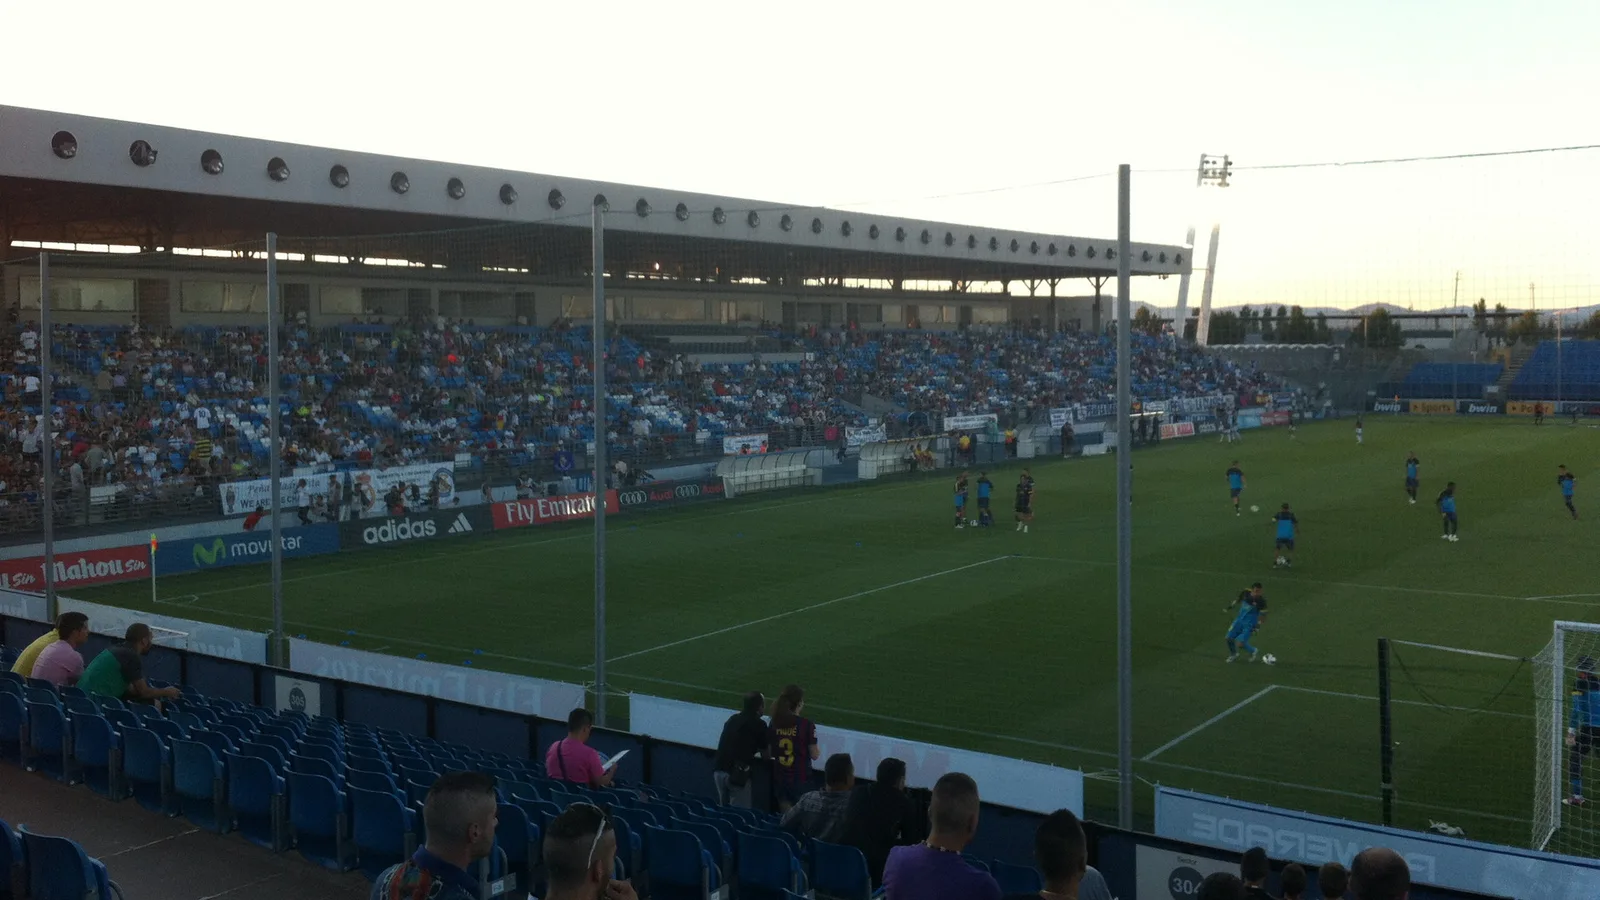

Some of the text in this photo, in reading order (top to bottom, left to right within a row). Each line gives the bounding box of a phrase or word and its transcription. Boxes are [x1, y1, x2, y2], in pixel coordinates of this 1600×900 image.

[1468, 403, 1498, 413] bwin
[1520, 404, 1549, 413] Por
[505, 502, 534, 524] Fly
[363, 517, 437, 549] adidas
[231, 535, 304, 557] movitar
[12, 572, 36, 587] Sin
[40, 557, 147, 583] Mahou Sin
[778, 737, 794, 767] 3
